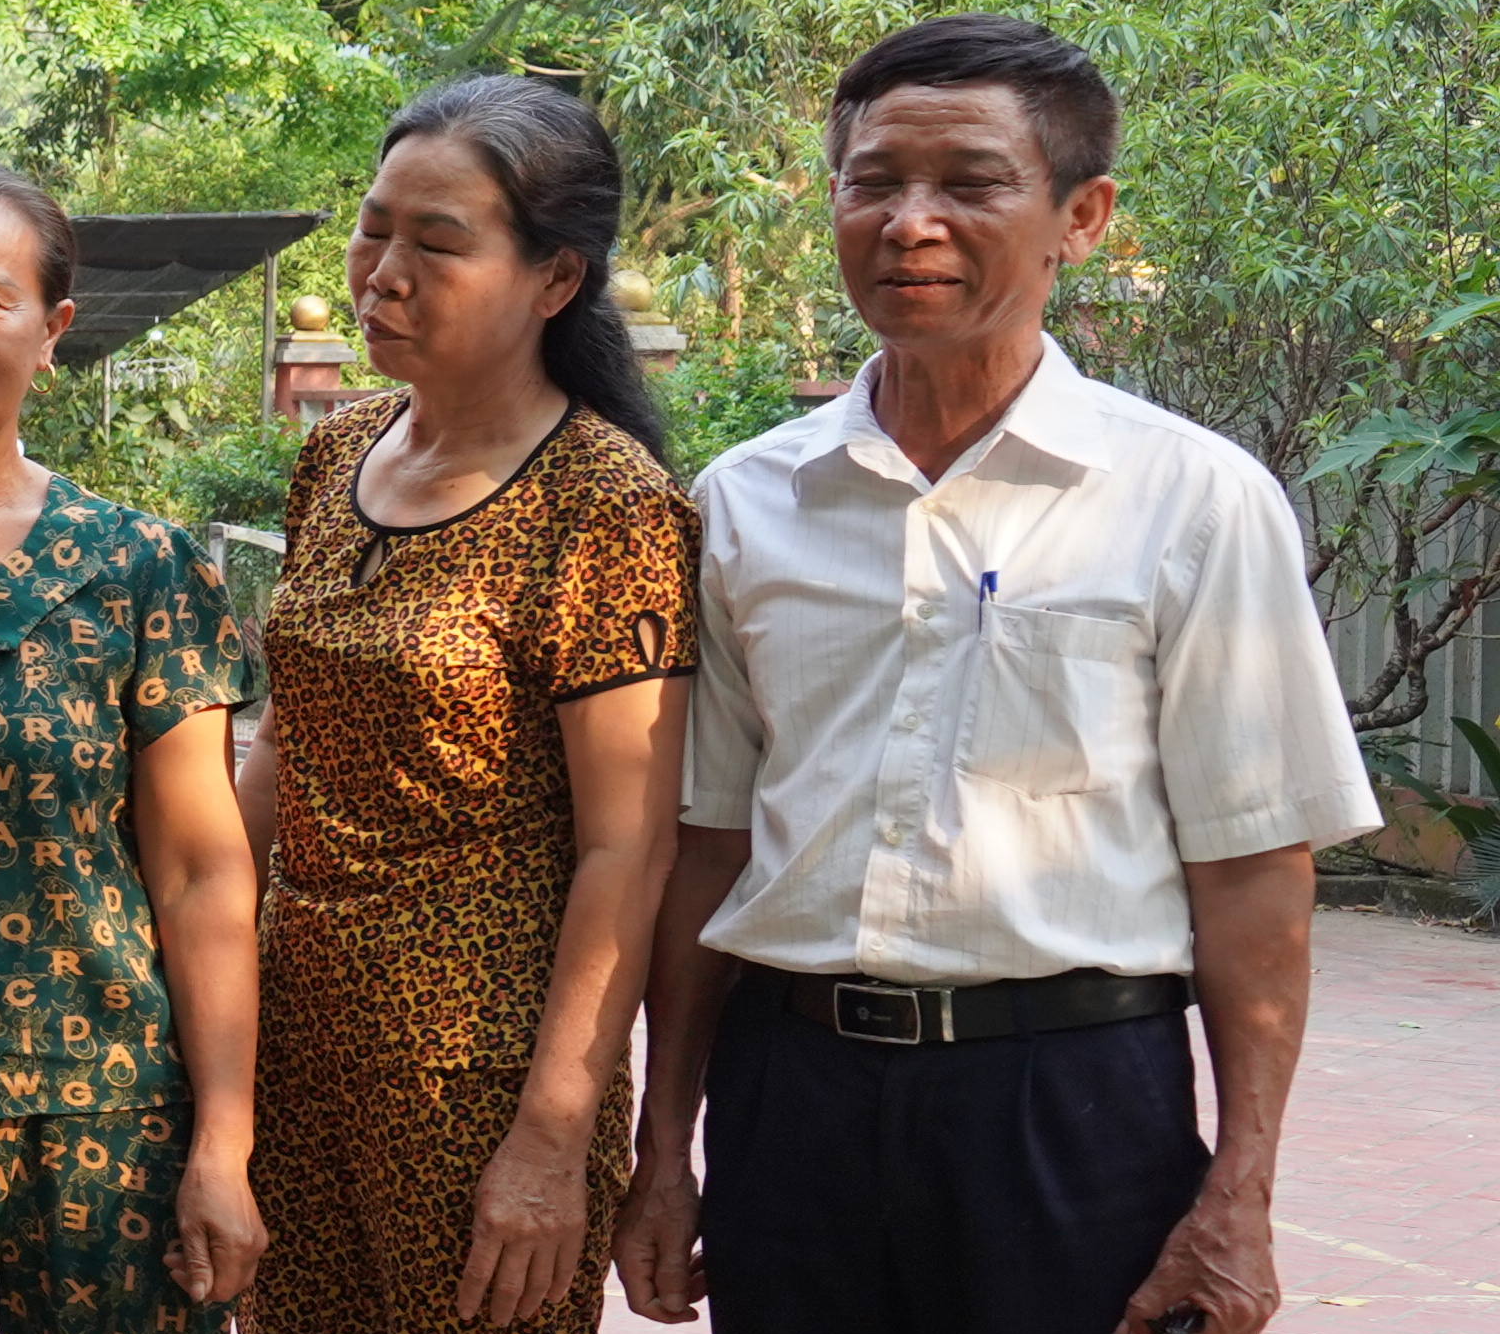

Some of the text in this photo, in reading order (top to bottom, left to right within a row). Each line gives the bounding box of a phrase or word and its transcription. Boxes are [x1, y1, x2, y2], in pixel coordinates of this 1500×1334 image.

[25, 718, 57, 741] R
[29, 774, 55, 799] Z
[35, 842, 66, 866] R
[52, 951, 84, 975] R
[4, 979, 36, 1006] C
